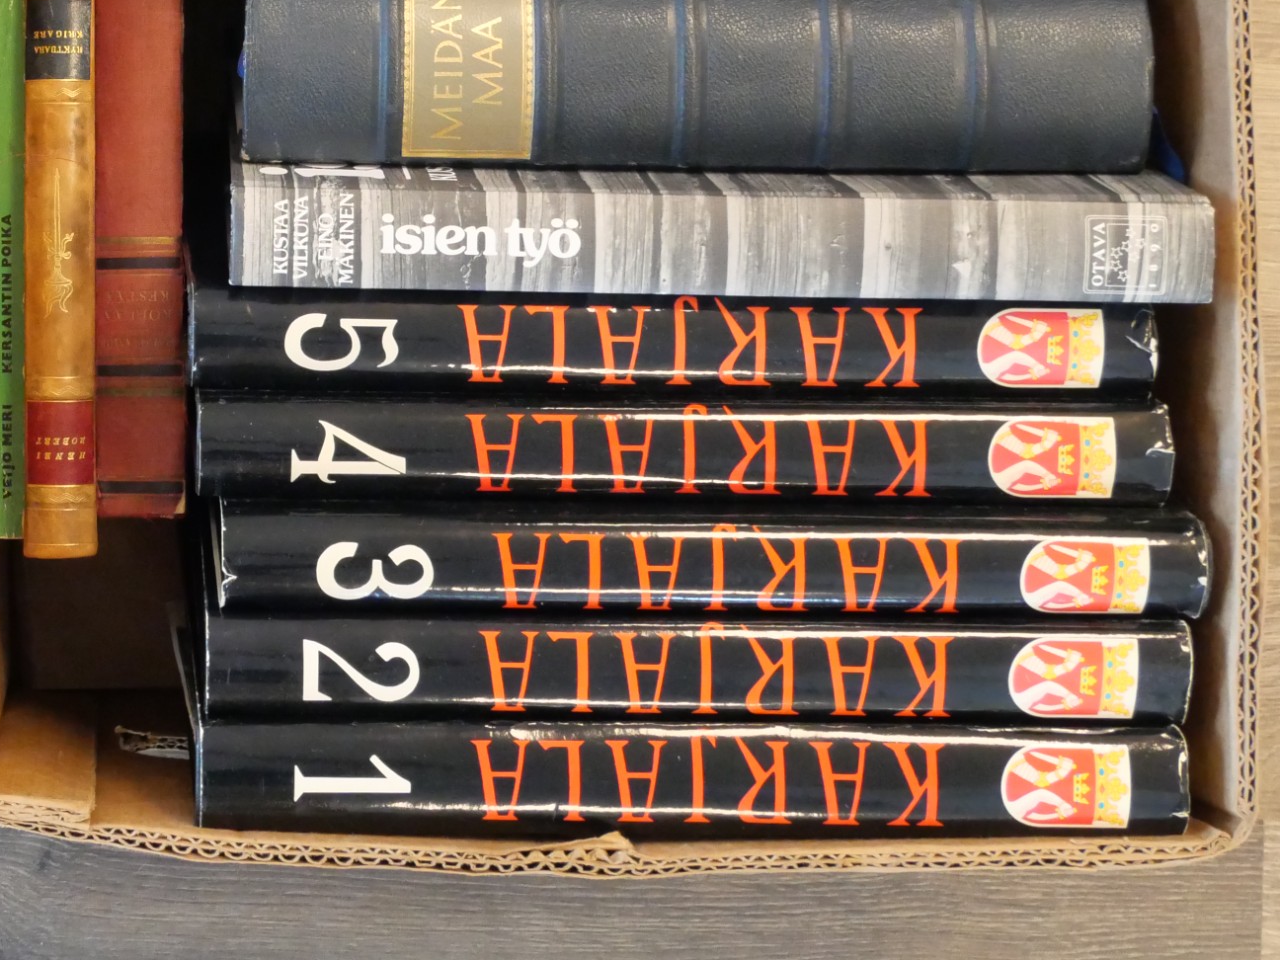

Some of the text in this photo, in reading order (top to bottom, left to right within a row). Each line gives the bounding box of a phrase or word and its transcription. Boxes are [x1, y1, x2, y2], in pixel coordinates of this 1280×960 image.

[33, 28, 84, 40] KRIGARE
[470, 16, 504, 107] MAA
[272, 198, 290, 275] KUSTAA
[293, 195, 310, 280] VILKUNA
[318, 212, 335, 262] EINO
[380, 212, 582, 268] isien työ
[1091, 222, 1107, 287] OTAVA
[1148, 222, 1162, 288] 1890
[0, 213, 16, 500] VEIJO MERI KERSANTIN POIKA
[284, 319, 400, 372] 5
[457, 295, 924, 388] KARJALA
[289, 419, 407, 484] 4
[465, 402, 933, 497] KARJALA
[317, 540, 436, 601] 3
[491, 524, 962, 613] KARJALA
[300, 639, 421, 703] 2
[478, 621, 956, 717] KARJALA
[292, 753, 413, 805] 1
[470, 734, 946, 827] KARJALA
